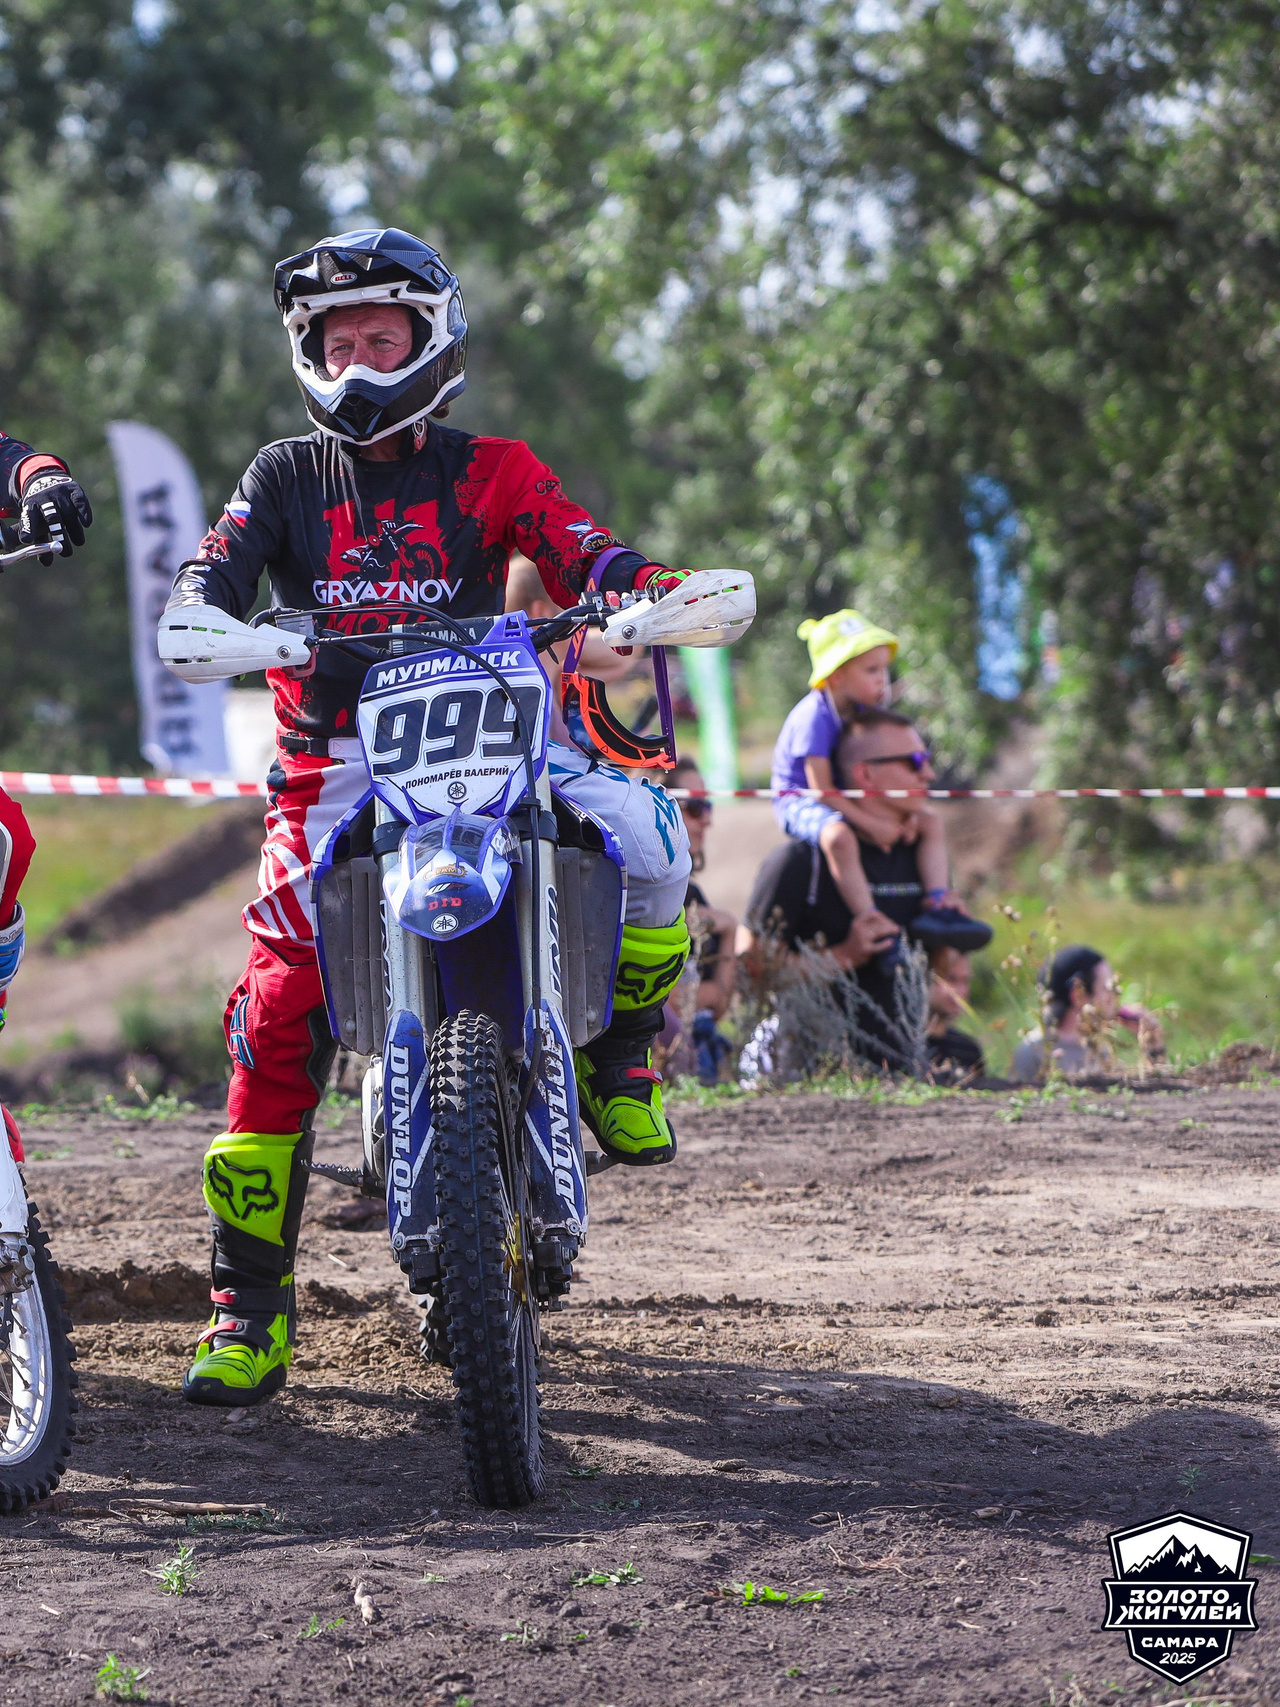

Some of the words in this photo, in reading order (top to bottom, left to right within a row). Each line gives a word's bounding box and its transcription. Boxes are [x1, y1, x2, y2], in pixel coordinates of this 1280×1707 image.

[312, 577, 464, 604] GRYAZNOV
[421, 627, 477, 645] YAMAA
[376, 650, 521, 688] МУРМАНСК
[372, 686, 542, 777] 999
[405, 769, 462, 789] ПОНОМАРЁВ
[464, 765, 509, 777] ВАЛЕРИЙ
[428, 897, 462, 911] DID
[390, 1041, 413, 1217] DUNLOP
